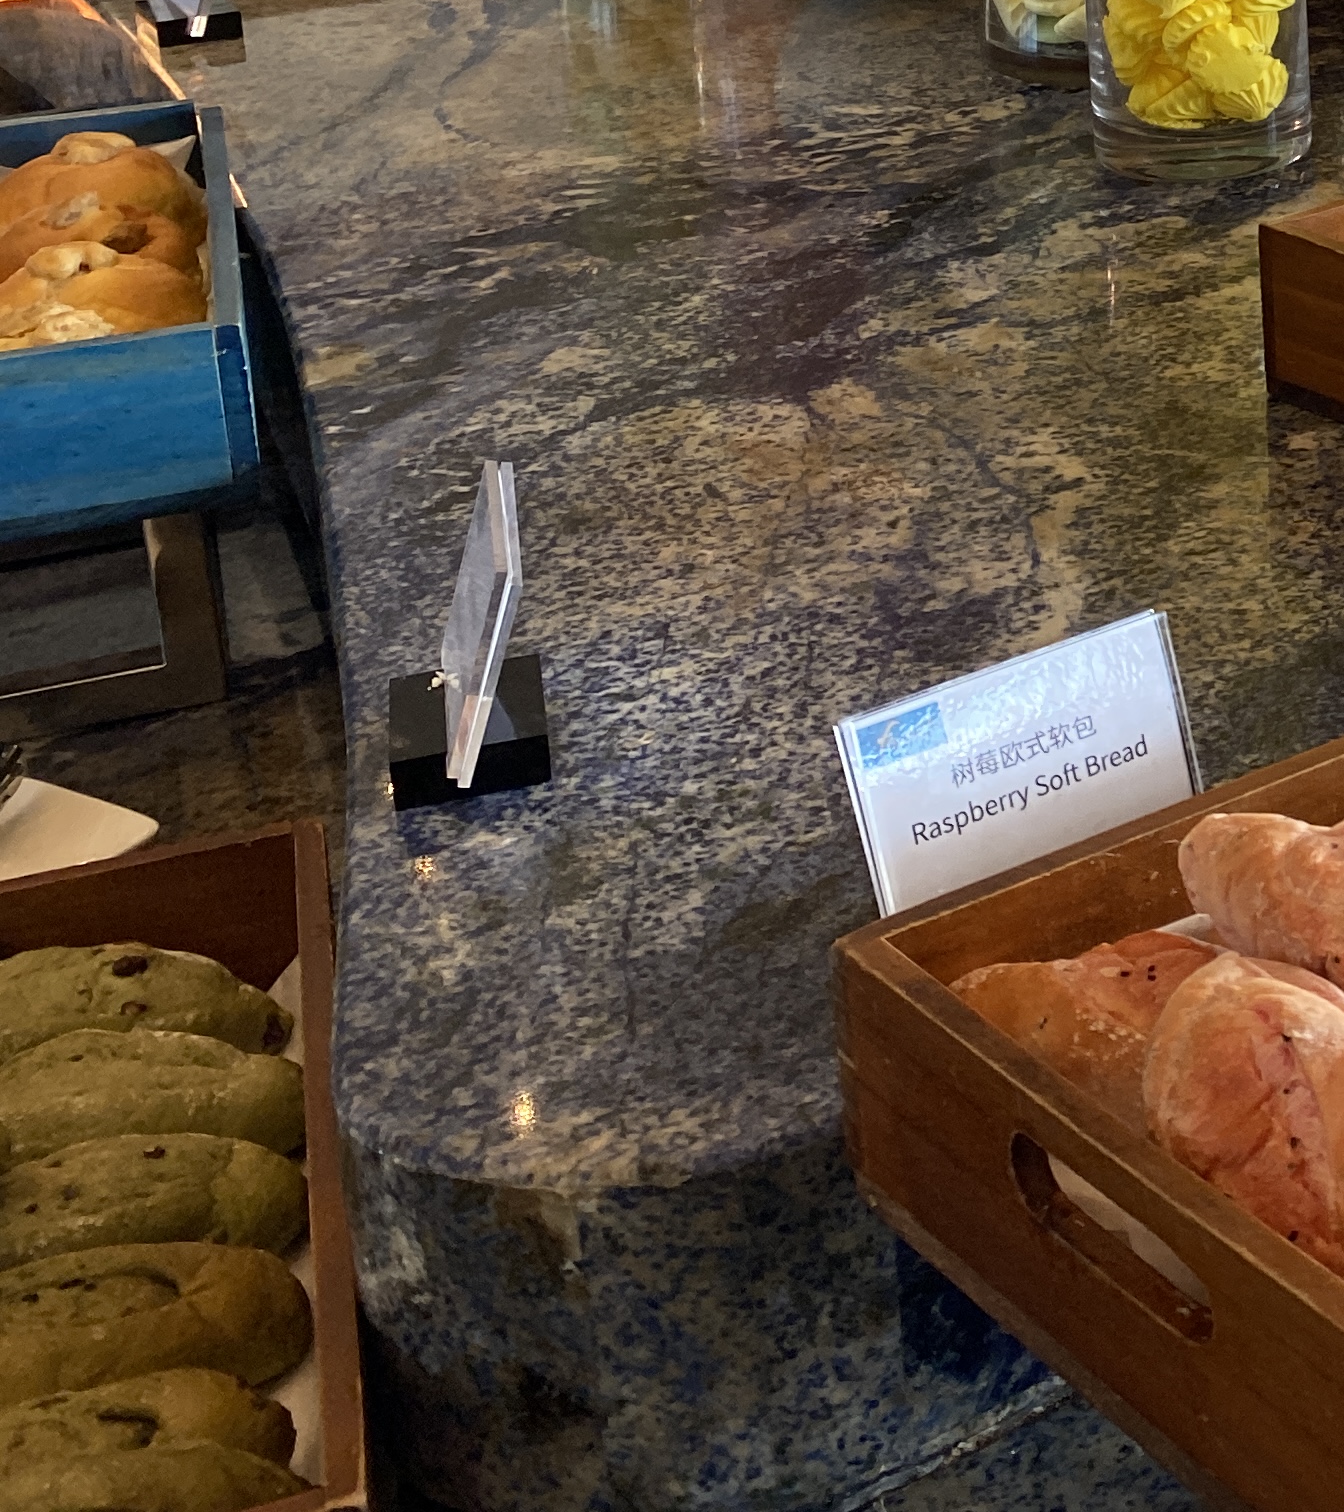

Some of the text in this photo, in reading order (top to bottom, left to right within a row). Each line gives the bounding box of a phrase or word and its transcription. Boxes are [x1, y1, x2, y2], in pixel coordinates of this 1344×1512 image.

[911, 734, 1149, 845] Raspberry Soft Bread
[950, 715, 1097, 788] 树莓欧式软包
